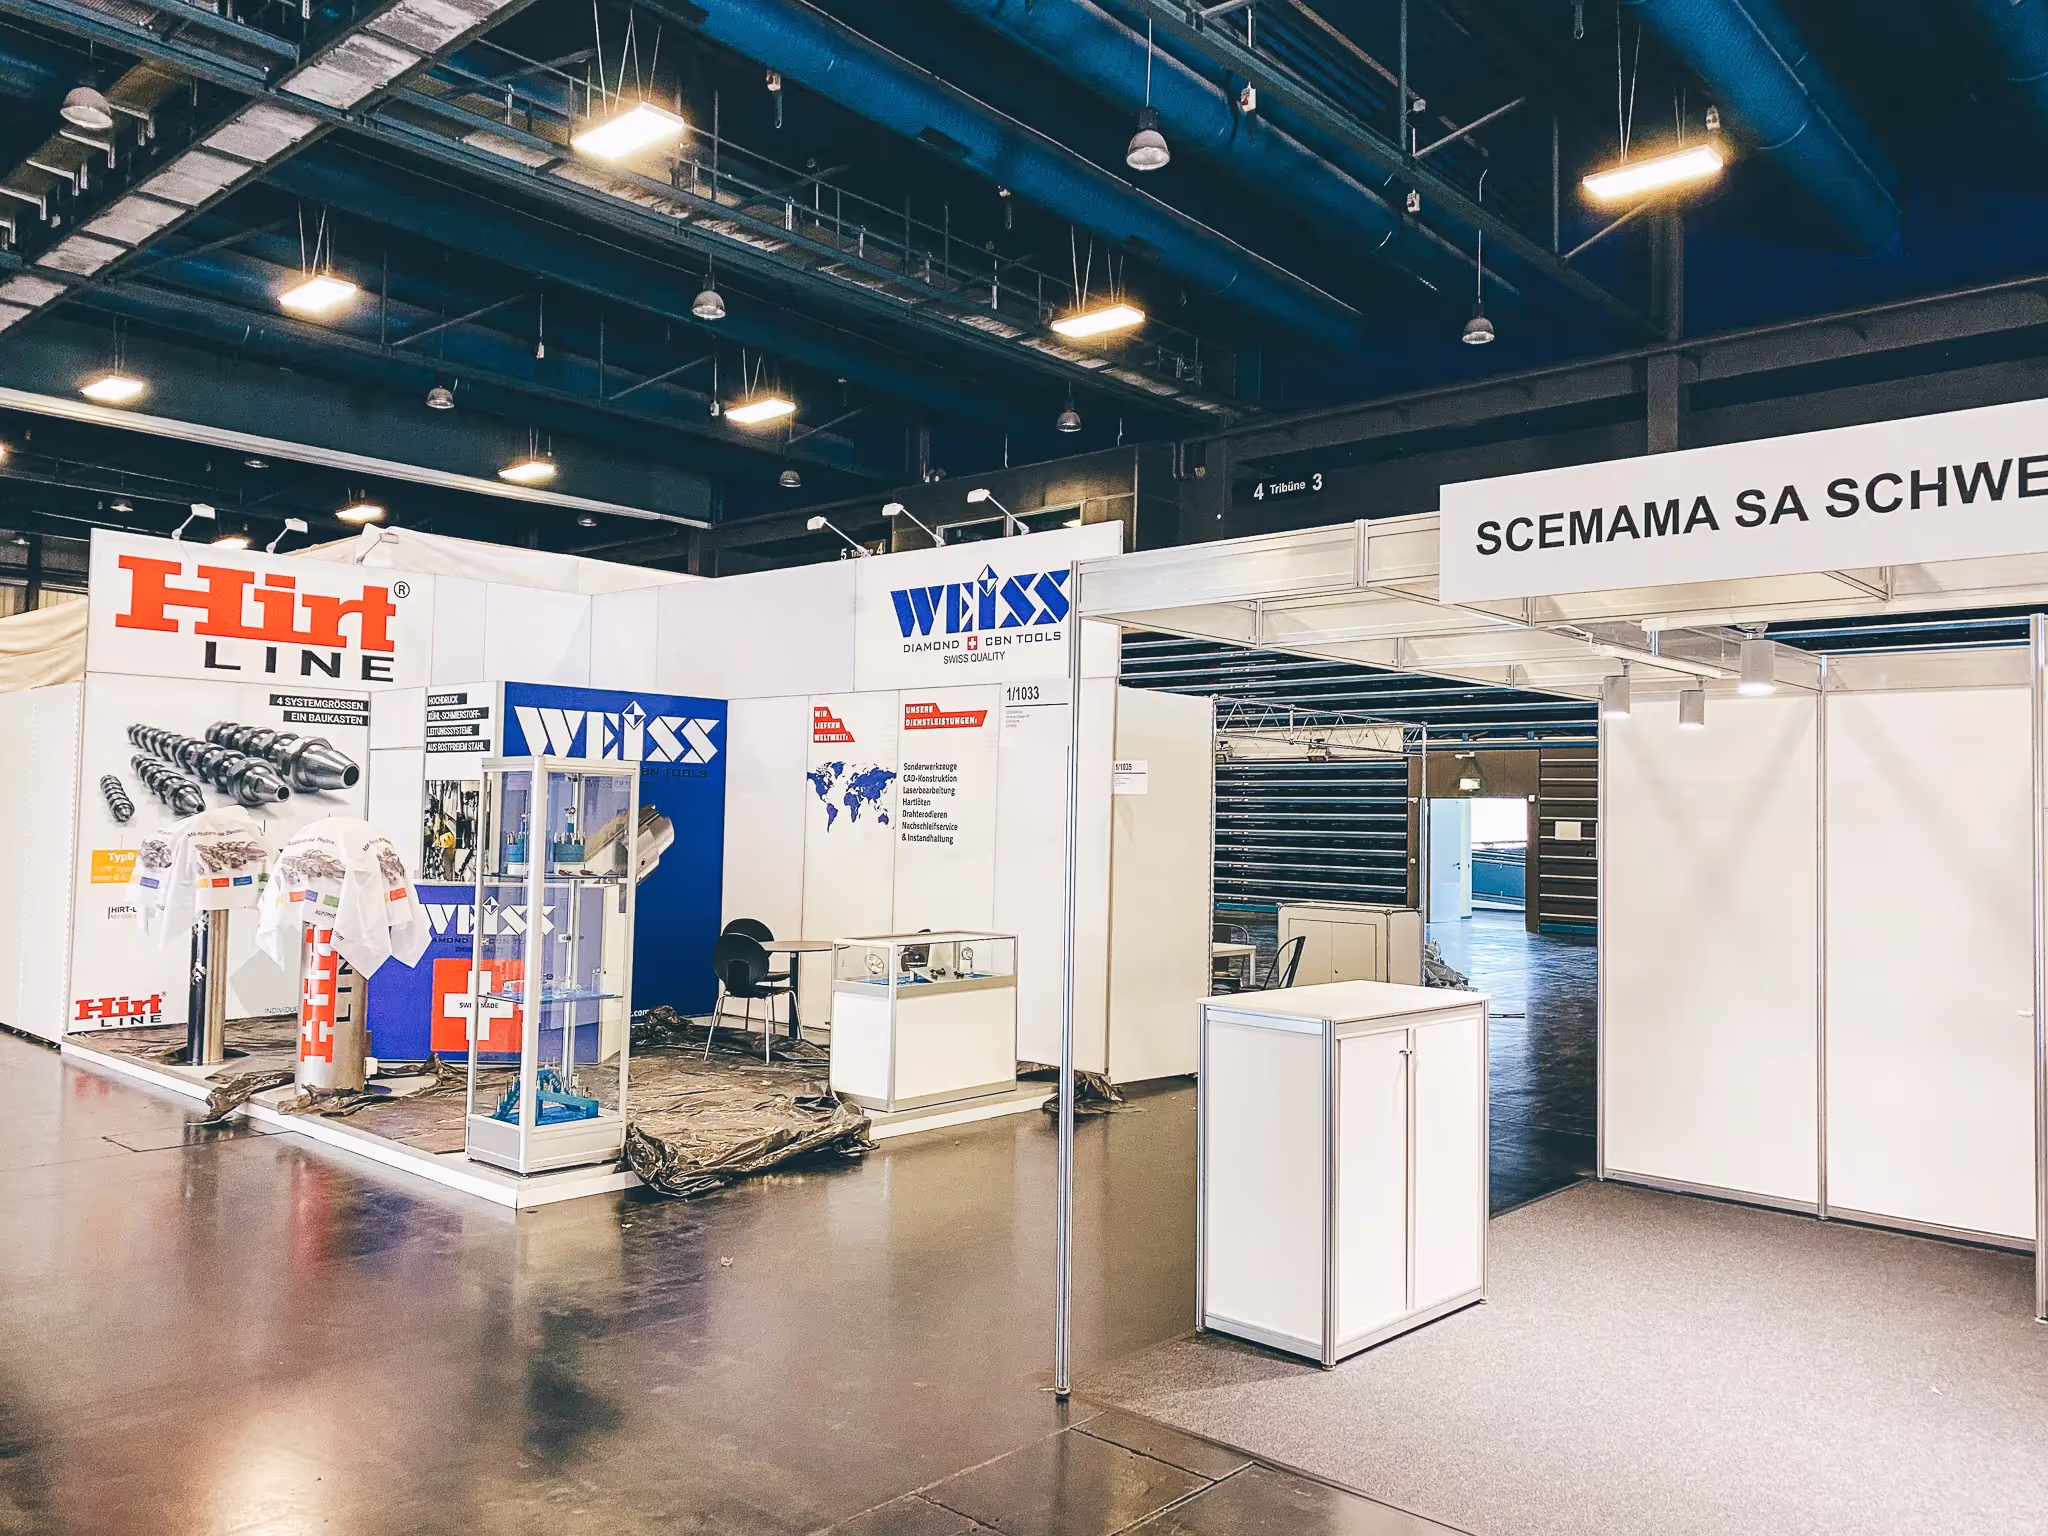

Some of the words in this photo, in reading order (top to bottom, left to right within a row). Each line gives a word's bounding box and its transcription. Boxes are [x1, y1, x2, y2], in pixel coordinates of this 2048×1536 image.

[1253, 483, 1264, 500] 4
[1269, 481, 1306, 495] Tribüne
[1312, 472, 1323, 491] 3
[1475, 494, 1720, 556] SCEMAMA
[1734, 484, 1809, 528] SA
[840, 548, 848, 561] 5
[876, 542, 885, 555] 4
[115, 554, 397, 652] Hirt
[903, 639, 960, 654] DIAMOND
[985, 635, 1012, 647] CBN
[1015, 631, 1062, 645] TOOLS
[204, 640, 395, 683] LINE
[943, 652, 969, 665] SWISS
[970, 651, 1006, 664] QUALITY
[1006, 686, 1040, 701] 1/1033
[276, 697, 283, 705] 4
[284, 697, 364, 710] SYSTEMGRÖSSEN
[428, 695, 458, 705] HOCHDRUCK
[814, 710, 828, 718] WIR
[905, 705, 934, 714] UNSERE
[291, 712, 307, 722] EIN
[308, 713, 363, 725] BAUKASTEN
[814, 721, 841, 730] LIEFERN
[903, 762, 958, 772] Sonderwerkzeuge
[1115, 763, 1132, 771] 1/1035
[903, 774, 957, 783] CAD-Konstruktion
[902, 786, 956, 797] Laserbearbeitung
[902, 797, 931, 806] Hartlöten
[902, 809, 948, 819] Drahterodieren
[902, 821, 958, 831] Nachschleifservice
[901, 833, 907, 841] &
[907, 834, 954, 845] Instandhaltung
[75, 994, 162, 1020] Hirt
[101, 1015, 161, 1027] LINE
